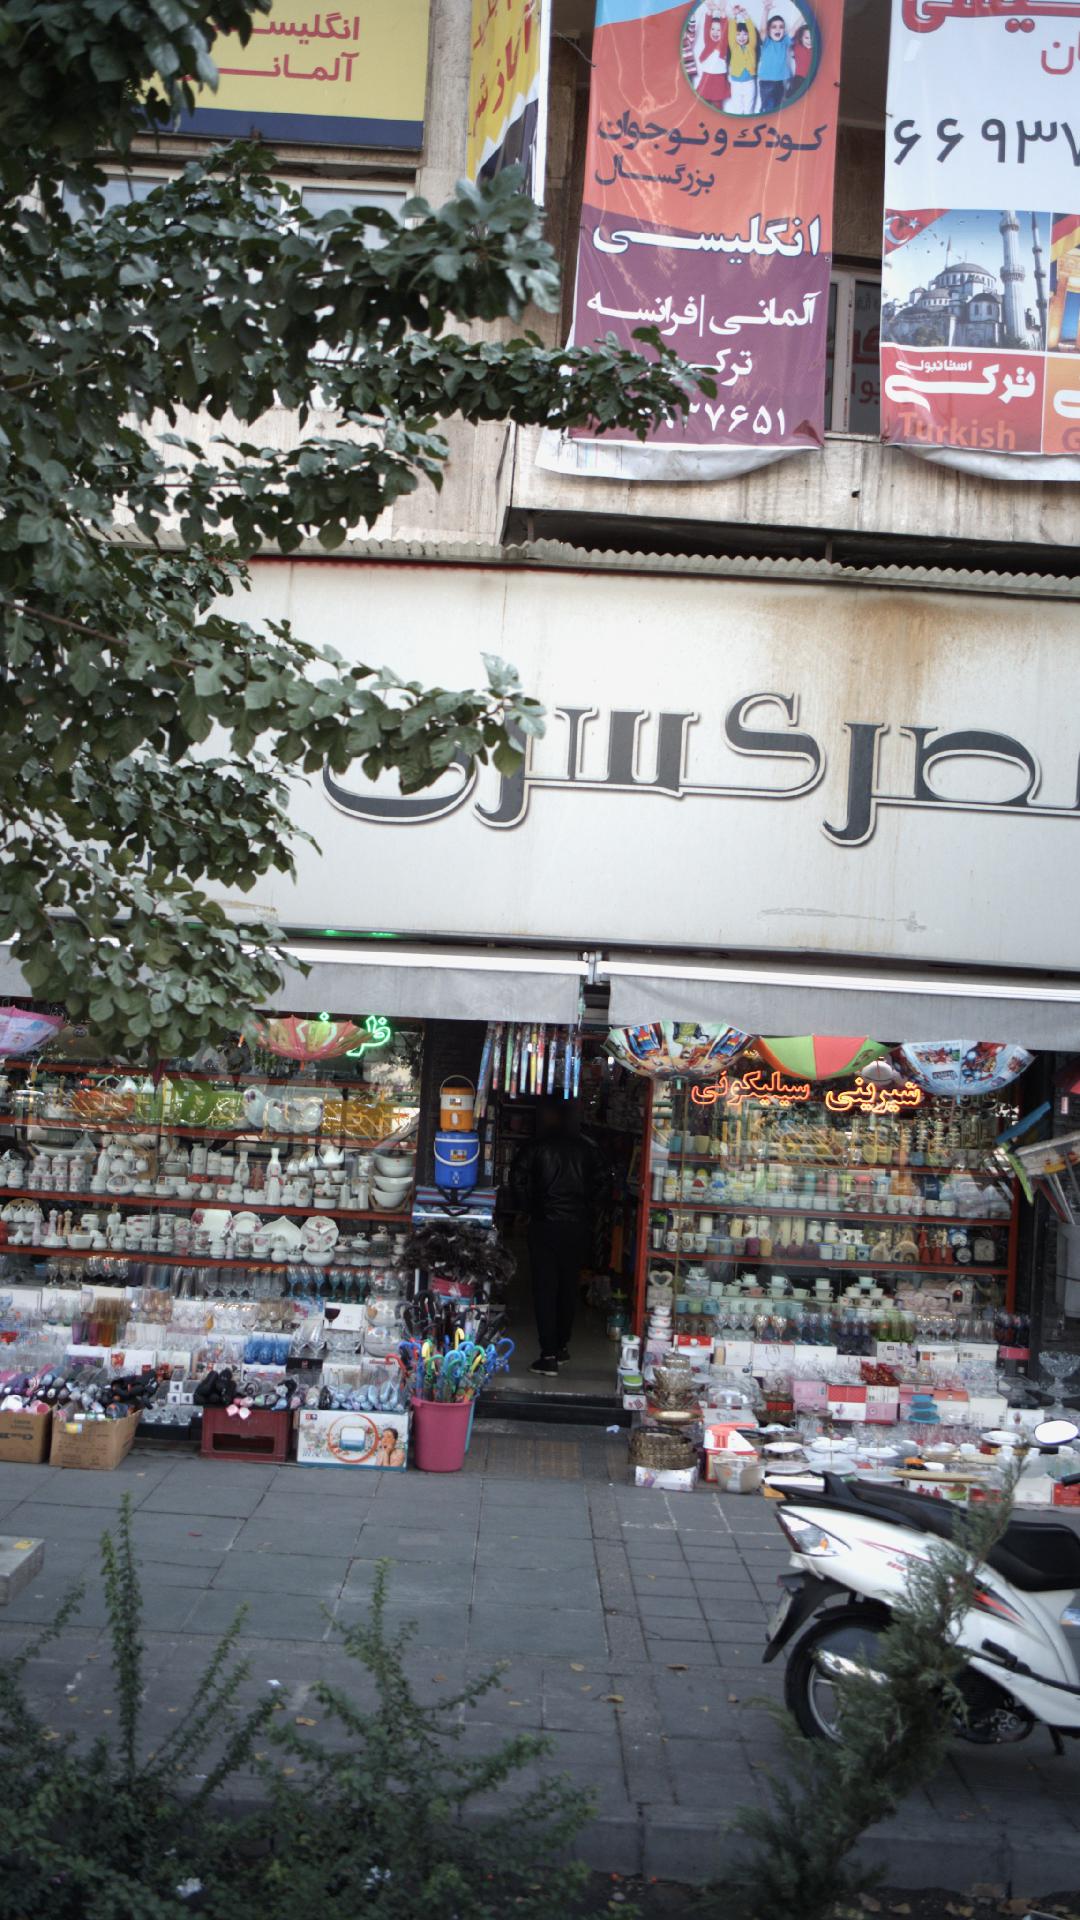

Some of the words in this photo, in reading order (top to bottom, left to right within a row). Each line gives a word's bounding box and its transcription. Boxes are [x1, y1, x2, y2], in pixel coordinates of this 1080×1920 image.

[213, 13, 360, 45] انگلیس
[180, 52, 360, 82] آلمان
[598, 111, 710, 155] نوجوان
[711, 131, 728, 156] و
[732, 124, 828, 162] کودک
[595, 154, 715, 197] بزرگسال
[592, 213, 821, 264] انگلیسی
[587, 292, 698, 336] فرانسه
[709, 291, 822, 335] آلمانی
[885, 364, 1036, 414] ترکی
[898, 412, 1016, 450] Turkish
[825, 1075, 922, 1113] شیرینی
